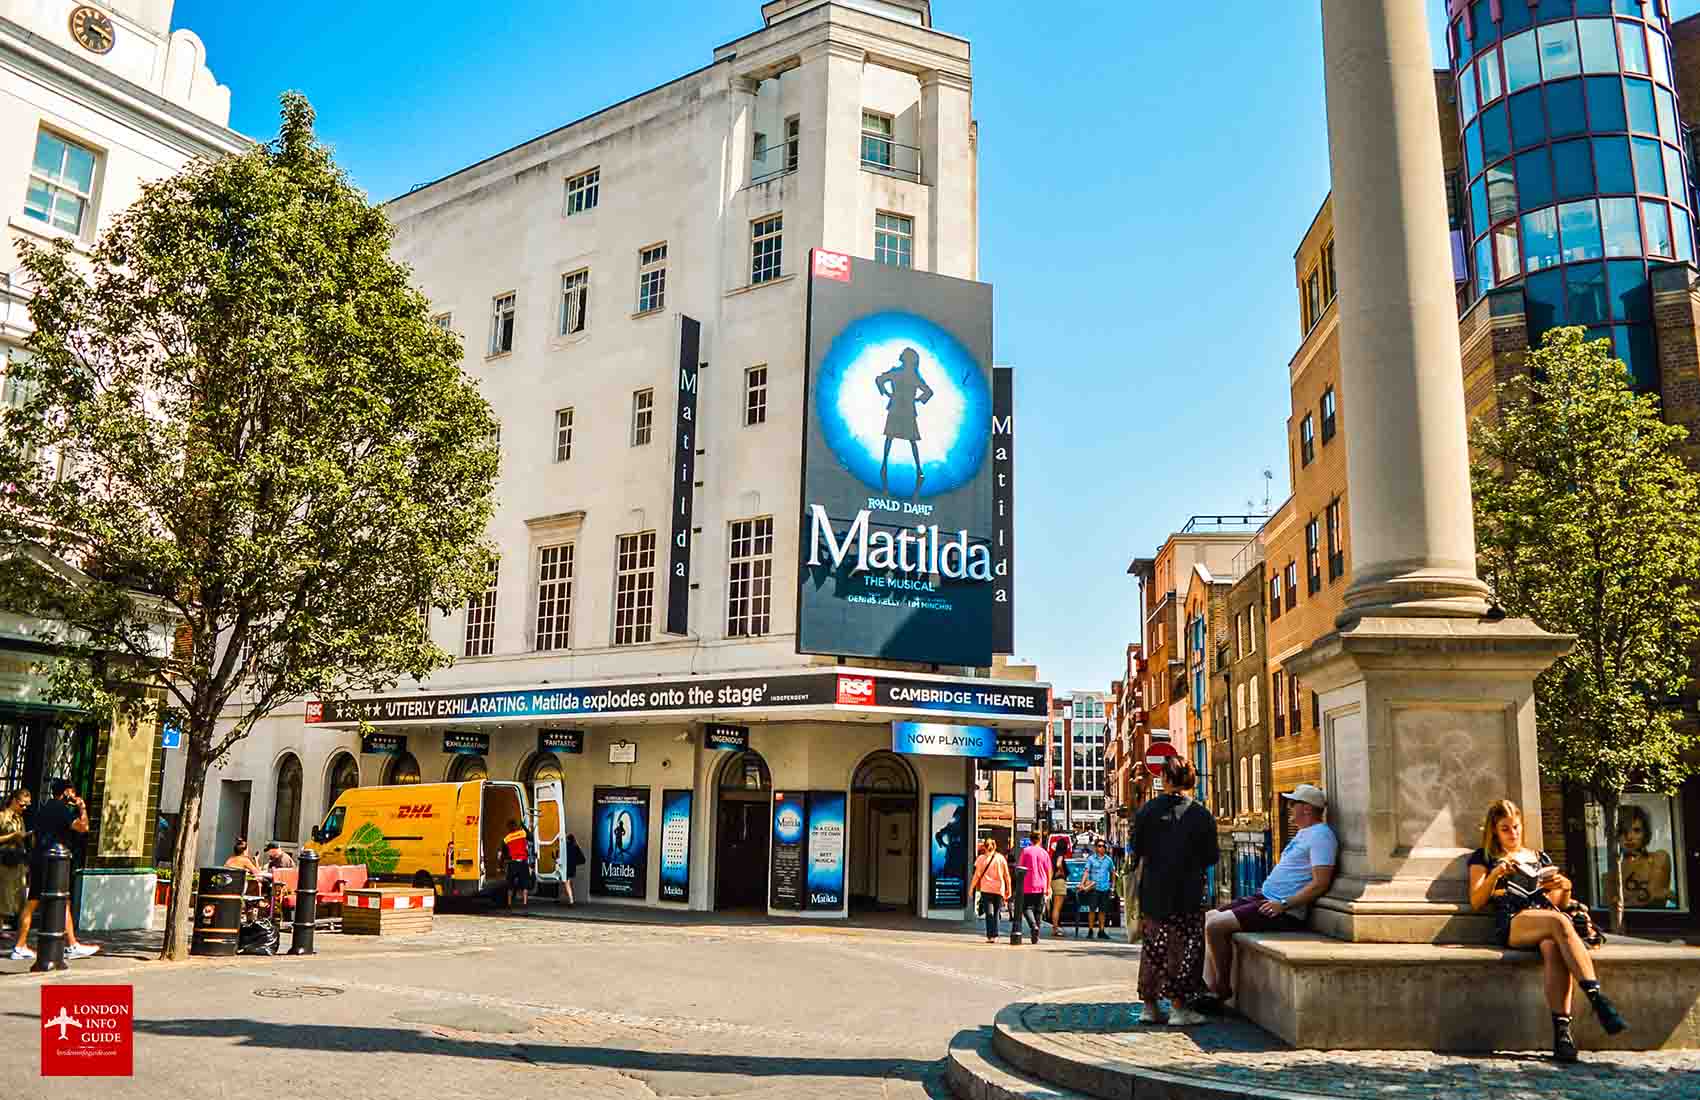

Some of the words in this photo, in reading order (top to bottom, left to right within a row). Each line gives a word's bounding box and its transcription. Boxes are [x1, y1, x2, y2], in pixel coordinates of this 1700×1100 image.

[815, 250, 849, 271] RSC
[676, 368, 697, 578] Matilda
[868, 498, 900, 512] ROALD
[991, 415, 1012, 602] Matilda
[807, 503, 994, 582] Matilda
[864, 576, 885, 588] THE
[887, 576, 936, 592] MUSICAL
[437, 695, 528, 715] EXHILARATING.
[532, 692, 579, 712] Matilda
[583, 689, 646, 712] explodes
[649, 688, 685, 707] onto
[688, 685, 714, 705] the
[839, 678, 873, 696] RSC
[889, 687, 972, 705] CAMBRIDGE
[976, 692, 1035, 709] THEATRE
[908, 733, 936, 745] NOW
[938, 735, 984, 748] PLAYING
[398, 803, 433, 819] DHL
[601, 862, 635, 878] Matilda
[811, 893, 838, 904] Matilda
